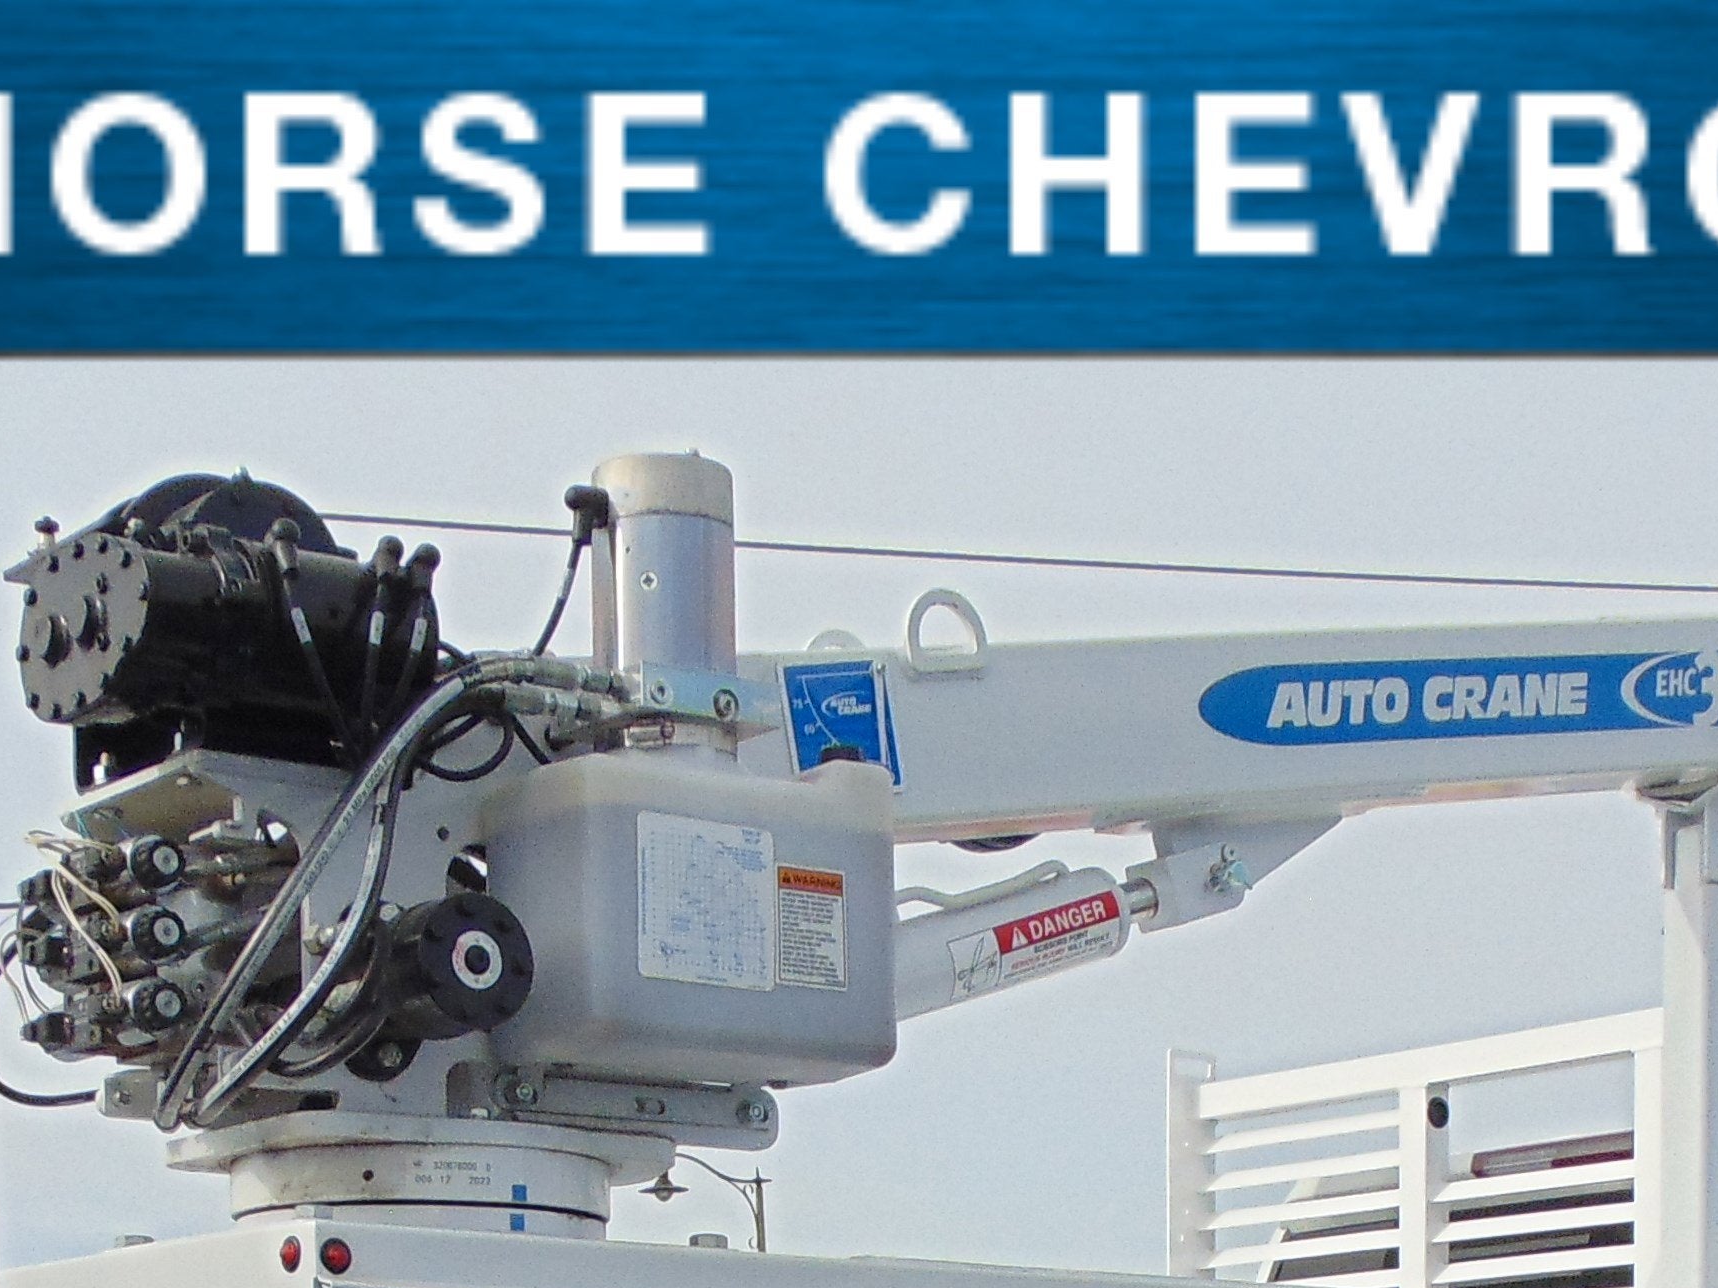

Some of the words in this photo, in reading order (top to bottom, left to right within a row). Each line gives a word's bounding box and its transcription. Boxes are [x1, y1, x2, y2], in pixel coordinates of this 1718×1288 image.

[1654, 666, 1696, 698] EHC
[830, 696, 858, 708] AUTO
[837, 704, 872, 716] CRANE
[1267, 675, 1409, 729] AUTO
[1421, 671, 1588, 723] CRANE
[1029, 899, 1107, 940] DANGER
